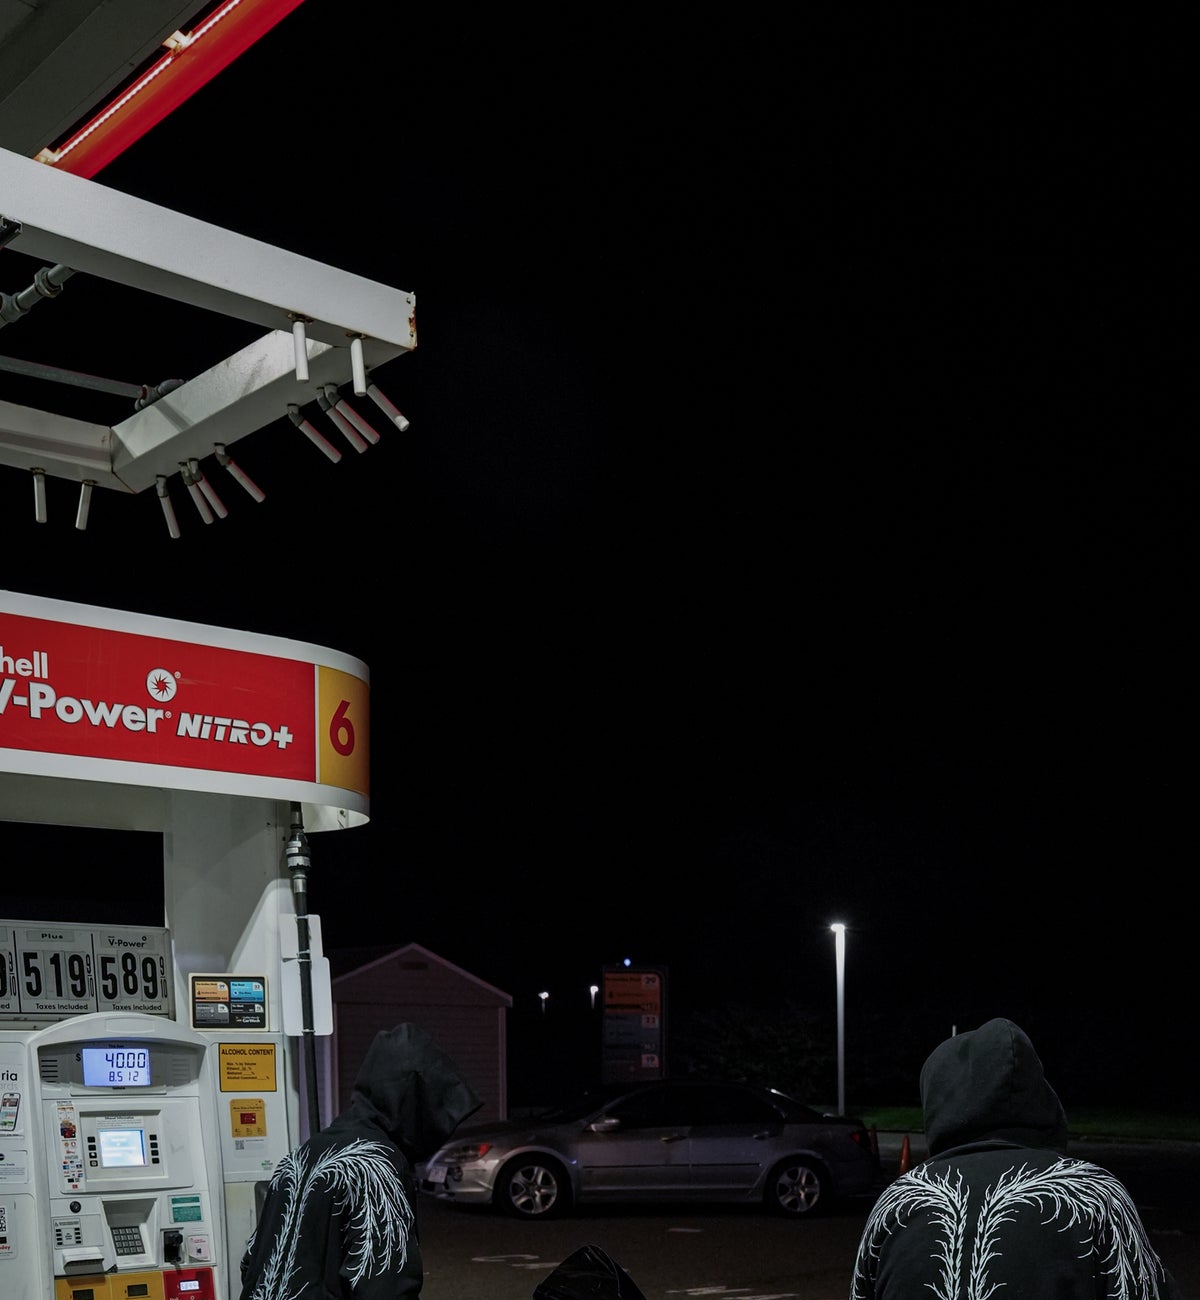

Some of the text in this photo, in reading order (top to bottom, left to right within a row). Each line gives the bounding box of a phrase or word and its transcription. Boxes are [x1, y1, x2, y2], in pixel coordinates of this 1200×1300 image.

[329, 699, 355, 757] 6
[108, 938, 145, 948] V-Power
[23, 952, 87, 998] 519
[100, 952, 158, 1000] 589
[112, 1003, 131, 1011] Taxes
[75, 1052, 146, 1069] $ 40.00
[109, 1071, 139, 1082] 8.512
